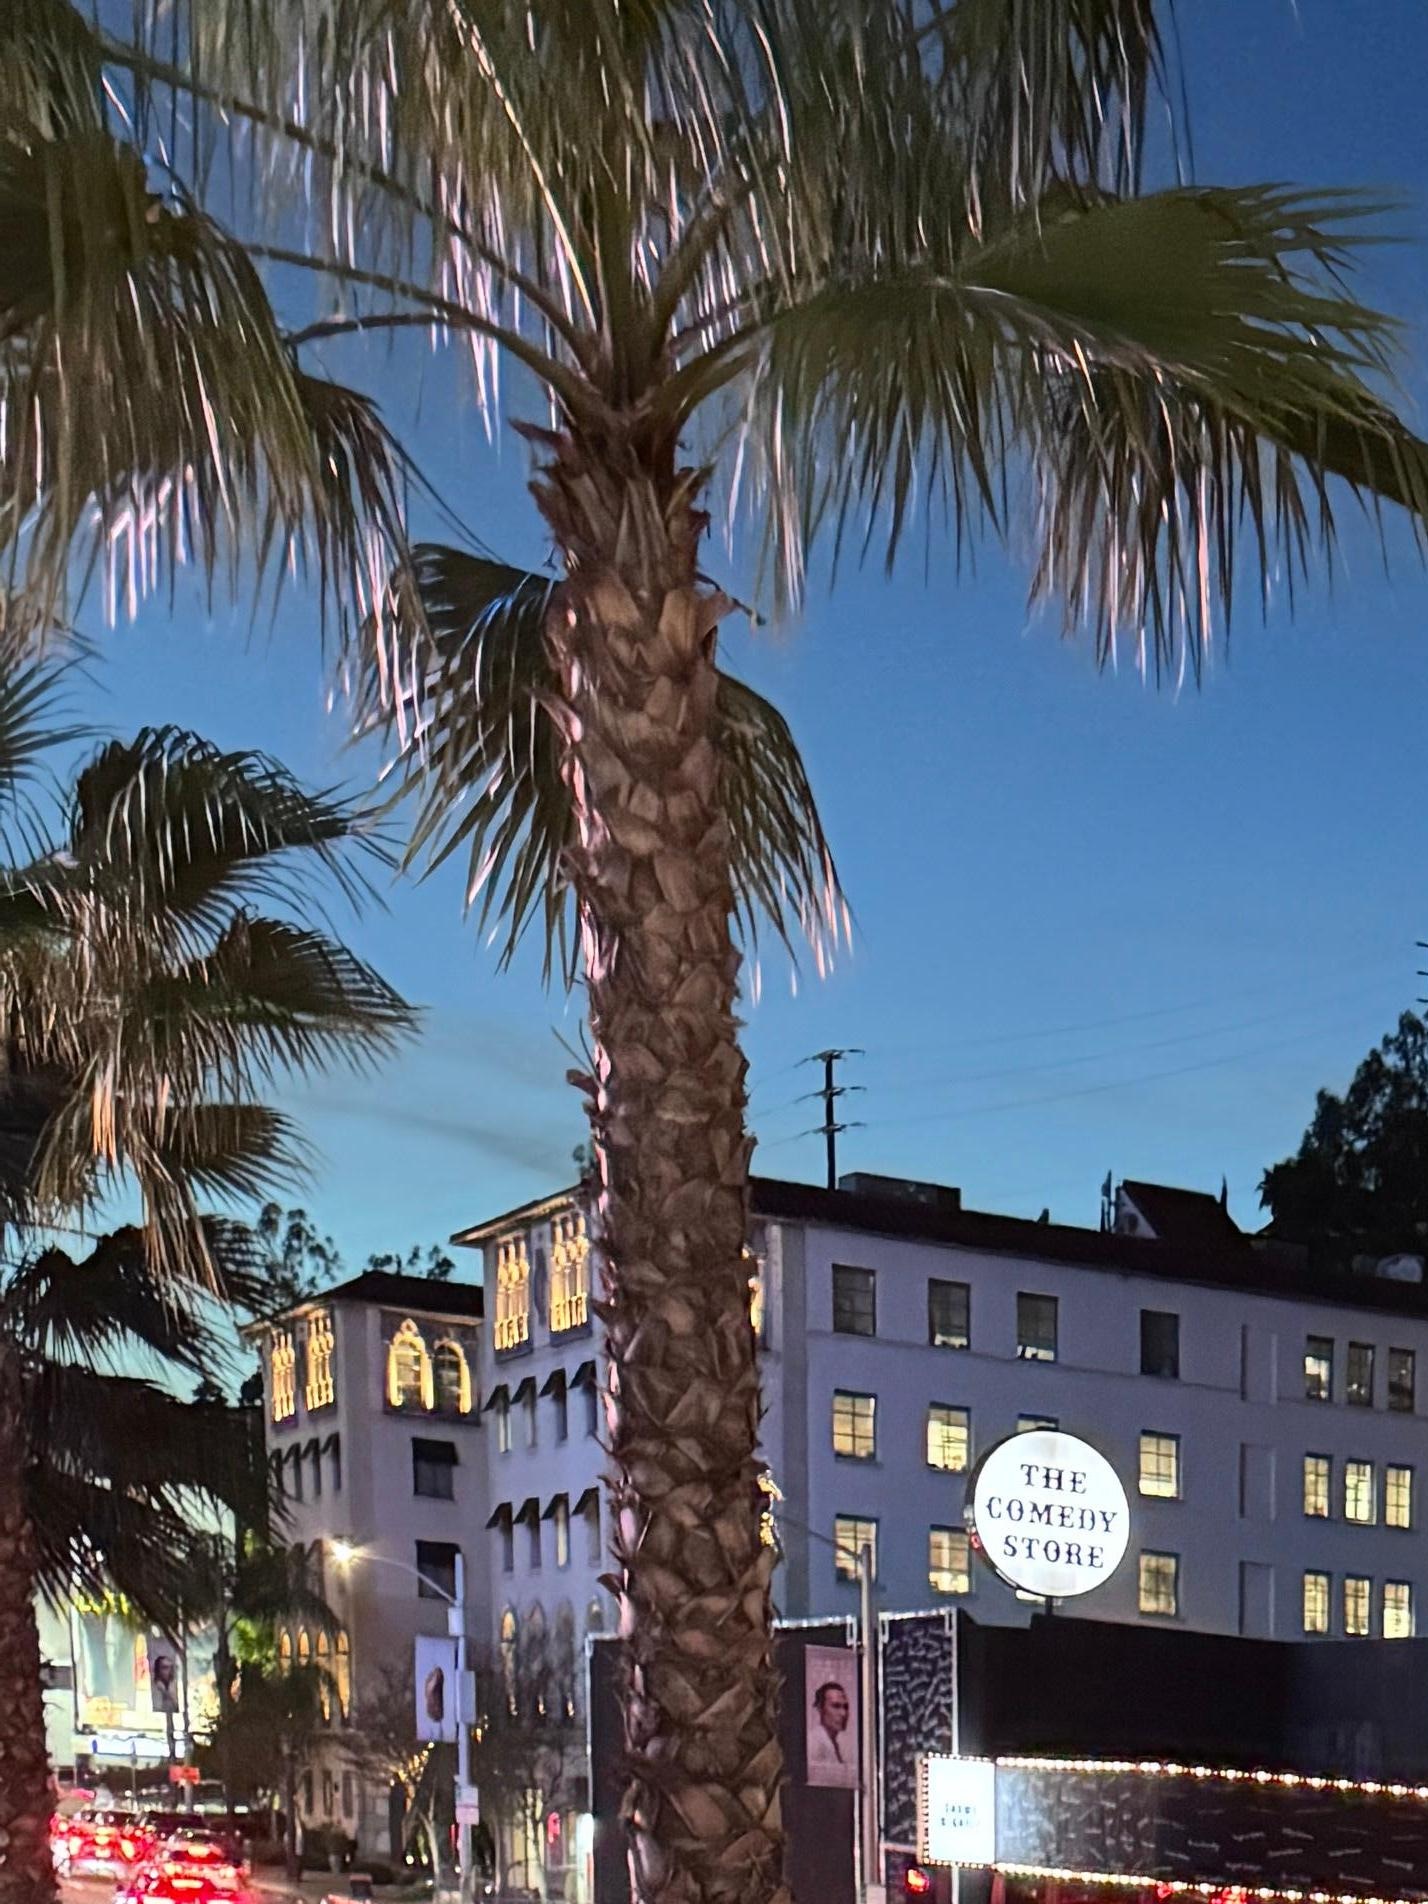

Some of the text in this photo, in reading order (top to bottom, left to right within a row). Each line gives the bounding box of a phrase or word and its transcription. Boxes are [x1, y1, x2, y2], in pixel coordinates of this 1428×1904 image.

[1020, 1463, 1088, 1495] THE
[985, 1496, 1119, 1533] COMEDY
[1003, 1534, 1105, 1569] STORE
